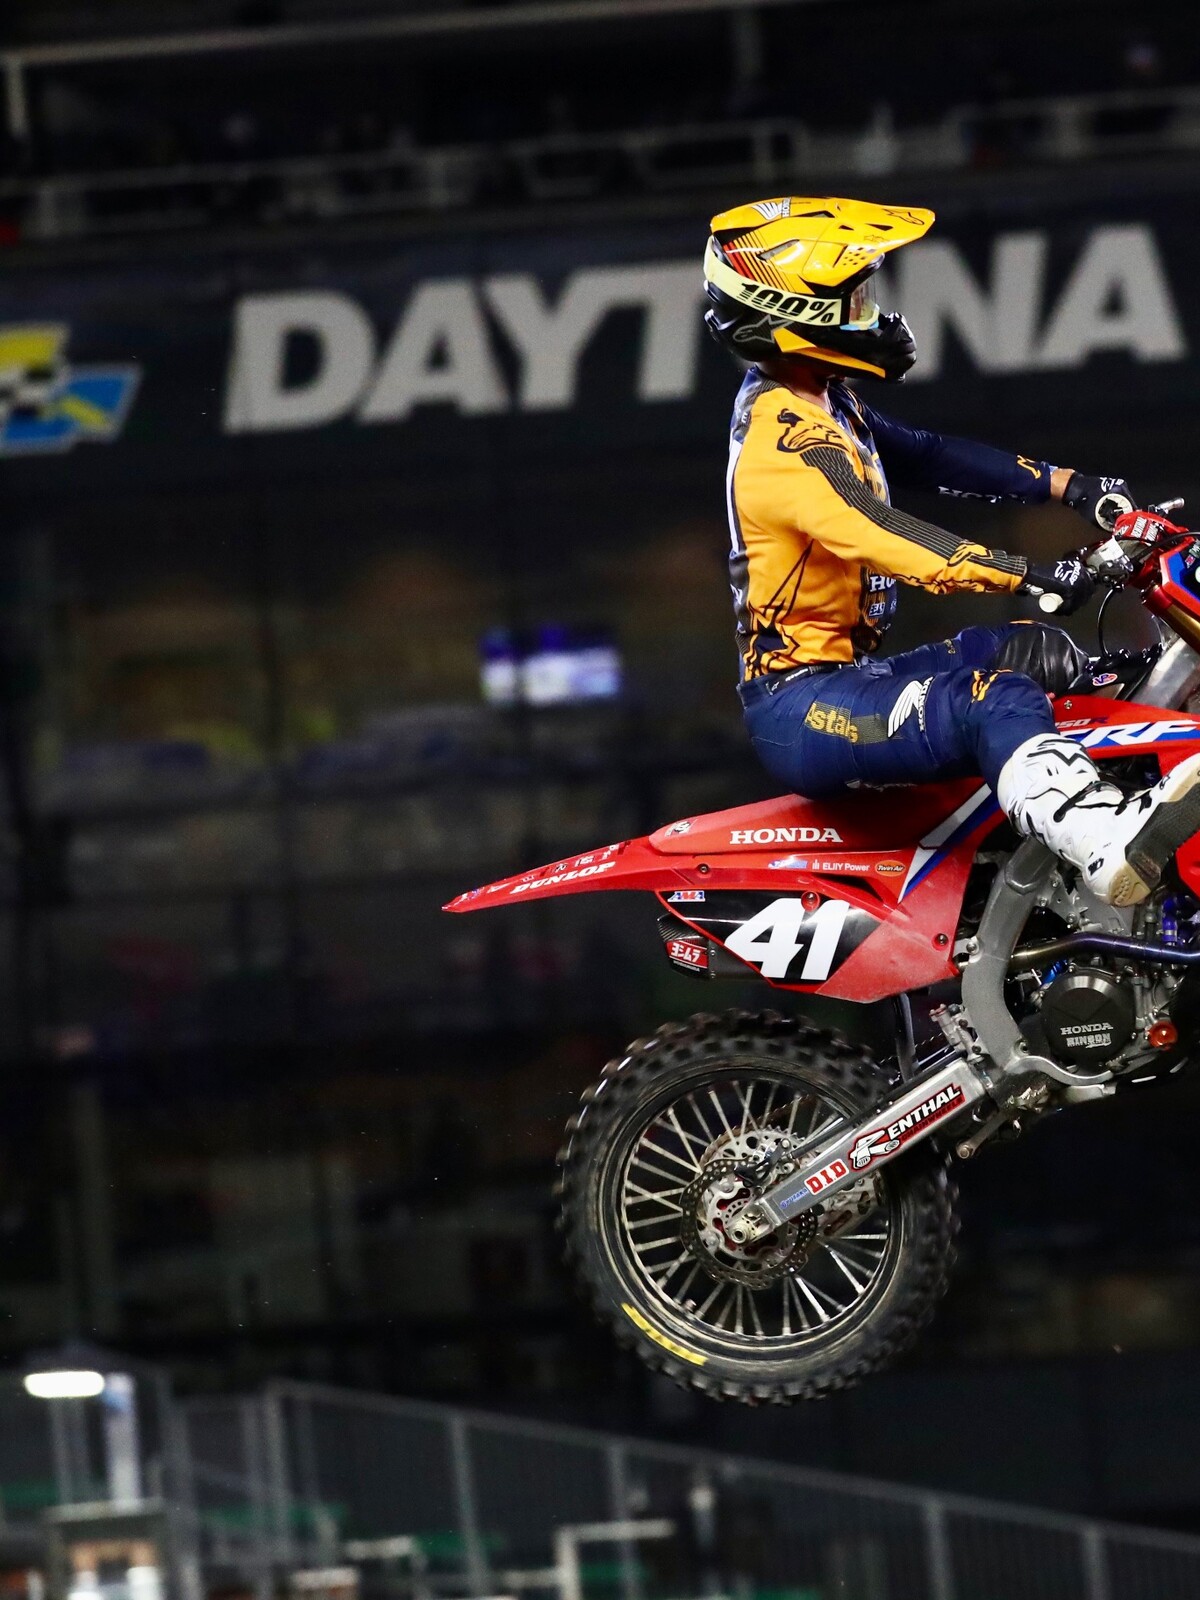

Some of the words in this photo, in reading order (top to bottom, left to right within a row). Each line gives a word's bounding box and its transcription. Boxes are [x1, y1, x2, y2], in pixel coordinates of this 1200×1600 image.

[737, 282, 835, 324] 100%
[222, 222, 1188, 435] DAYTNA
[918, 676, 934, 732] HONDA
[1055, 716, 1109, 729] 50R
[729, 827, 844, 845] HONDA
[509, 861, 616, 894] DUNLOP
[844, 862, 870, 871] Power
[723, 897, 850, 981] 41
[1060, 1022, 1114, 1035] HONDA
